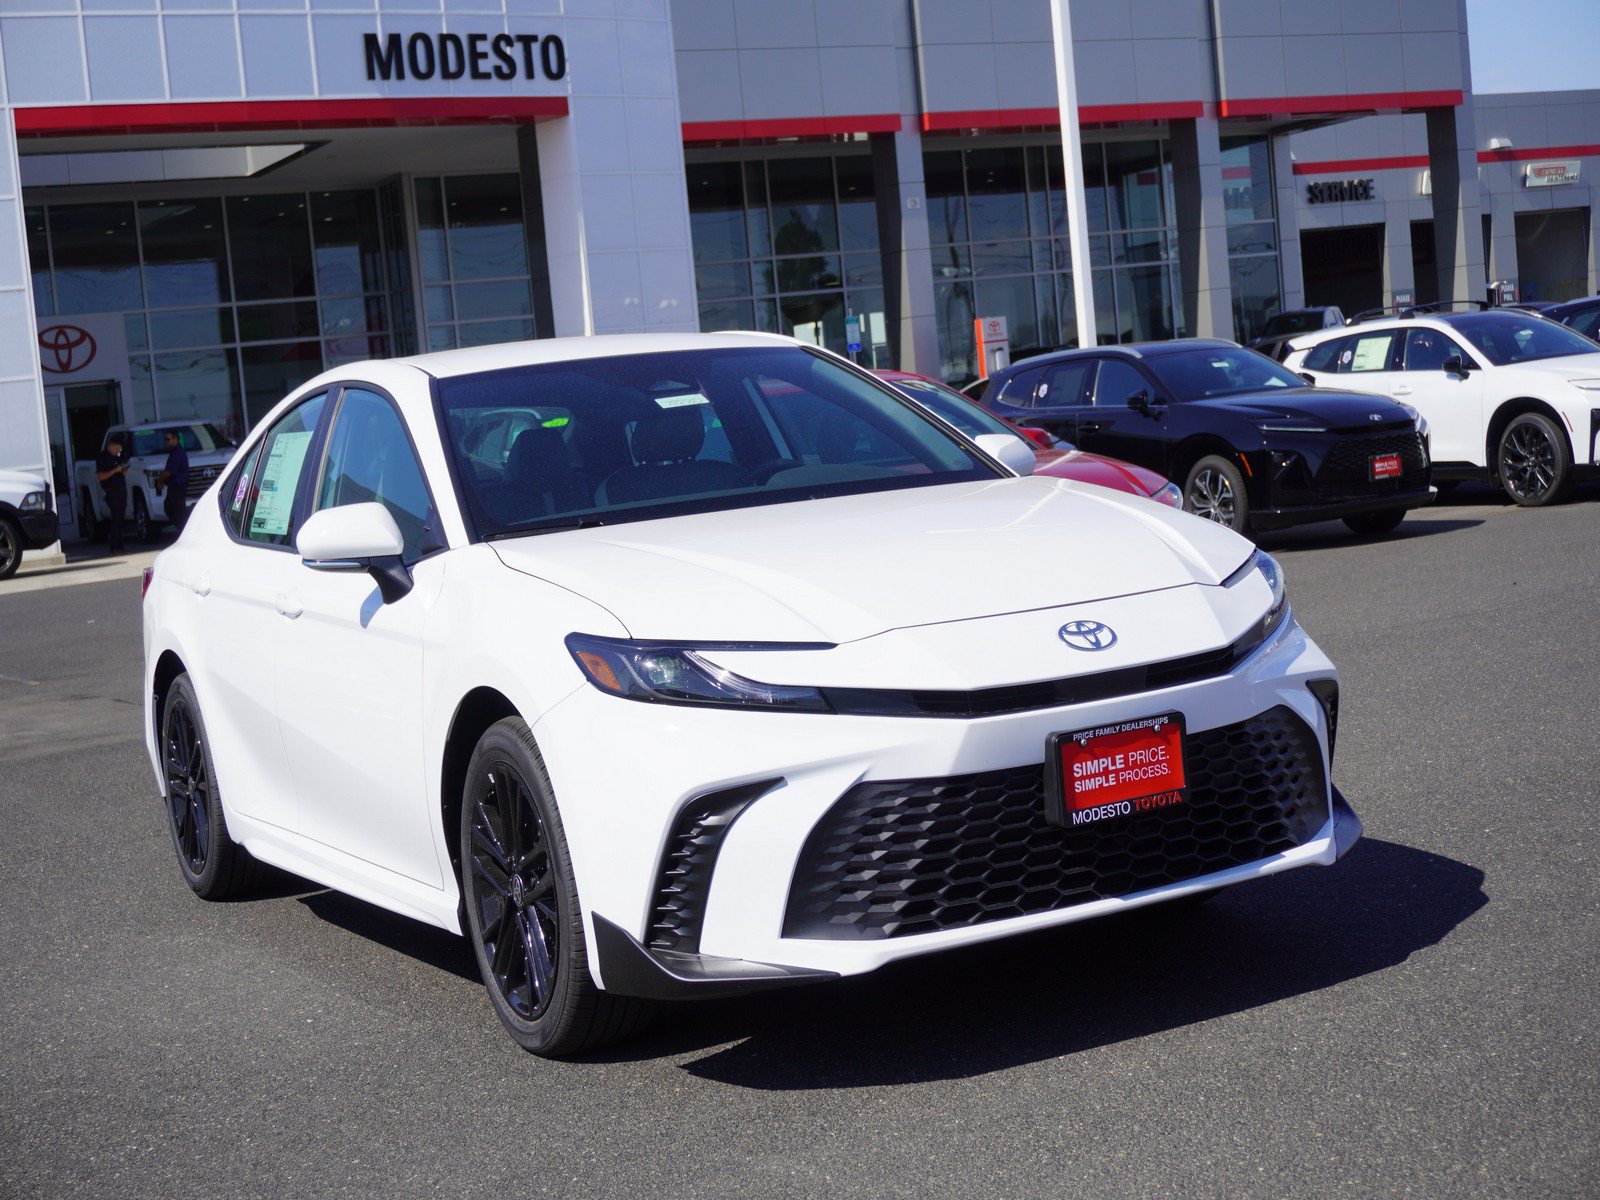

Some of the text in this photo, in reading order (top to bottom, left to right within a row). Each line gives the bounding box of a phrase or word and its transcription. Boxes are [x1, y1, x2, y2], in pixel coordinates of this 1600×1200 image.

[363, 31, 566, 81] MODESTO
[1307, 178, 1375, 204] SERVICE
[1073, 716, 1169, 741] PRICE FAMILY DEALERSHIPS
[1073, 745, 1170, 778] SIMPLE PRICE.
[1074, 763, 1171, 793] SIMPLE PROCESS.
[1072, 791, 1182, 825] MODESTO TOYOTA
